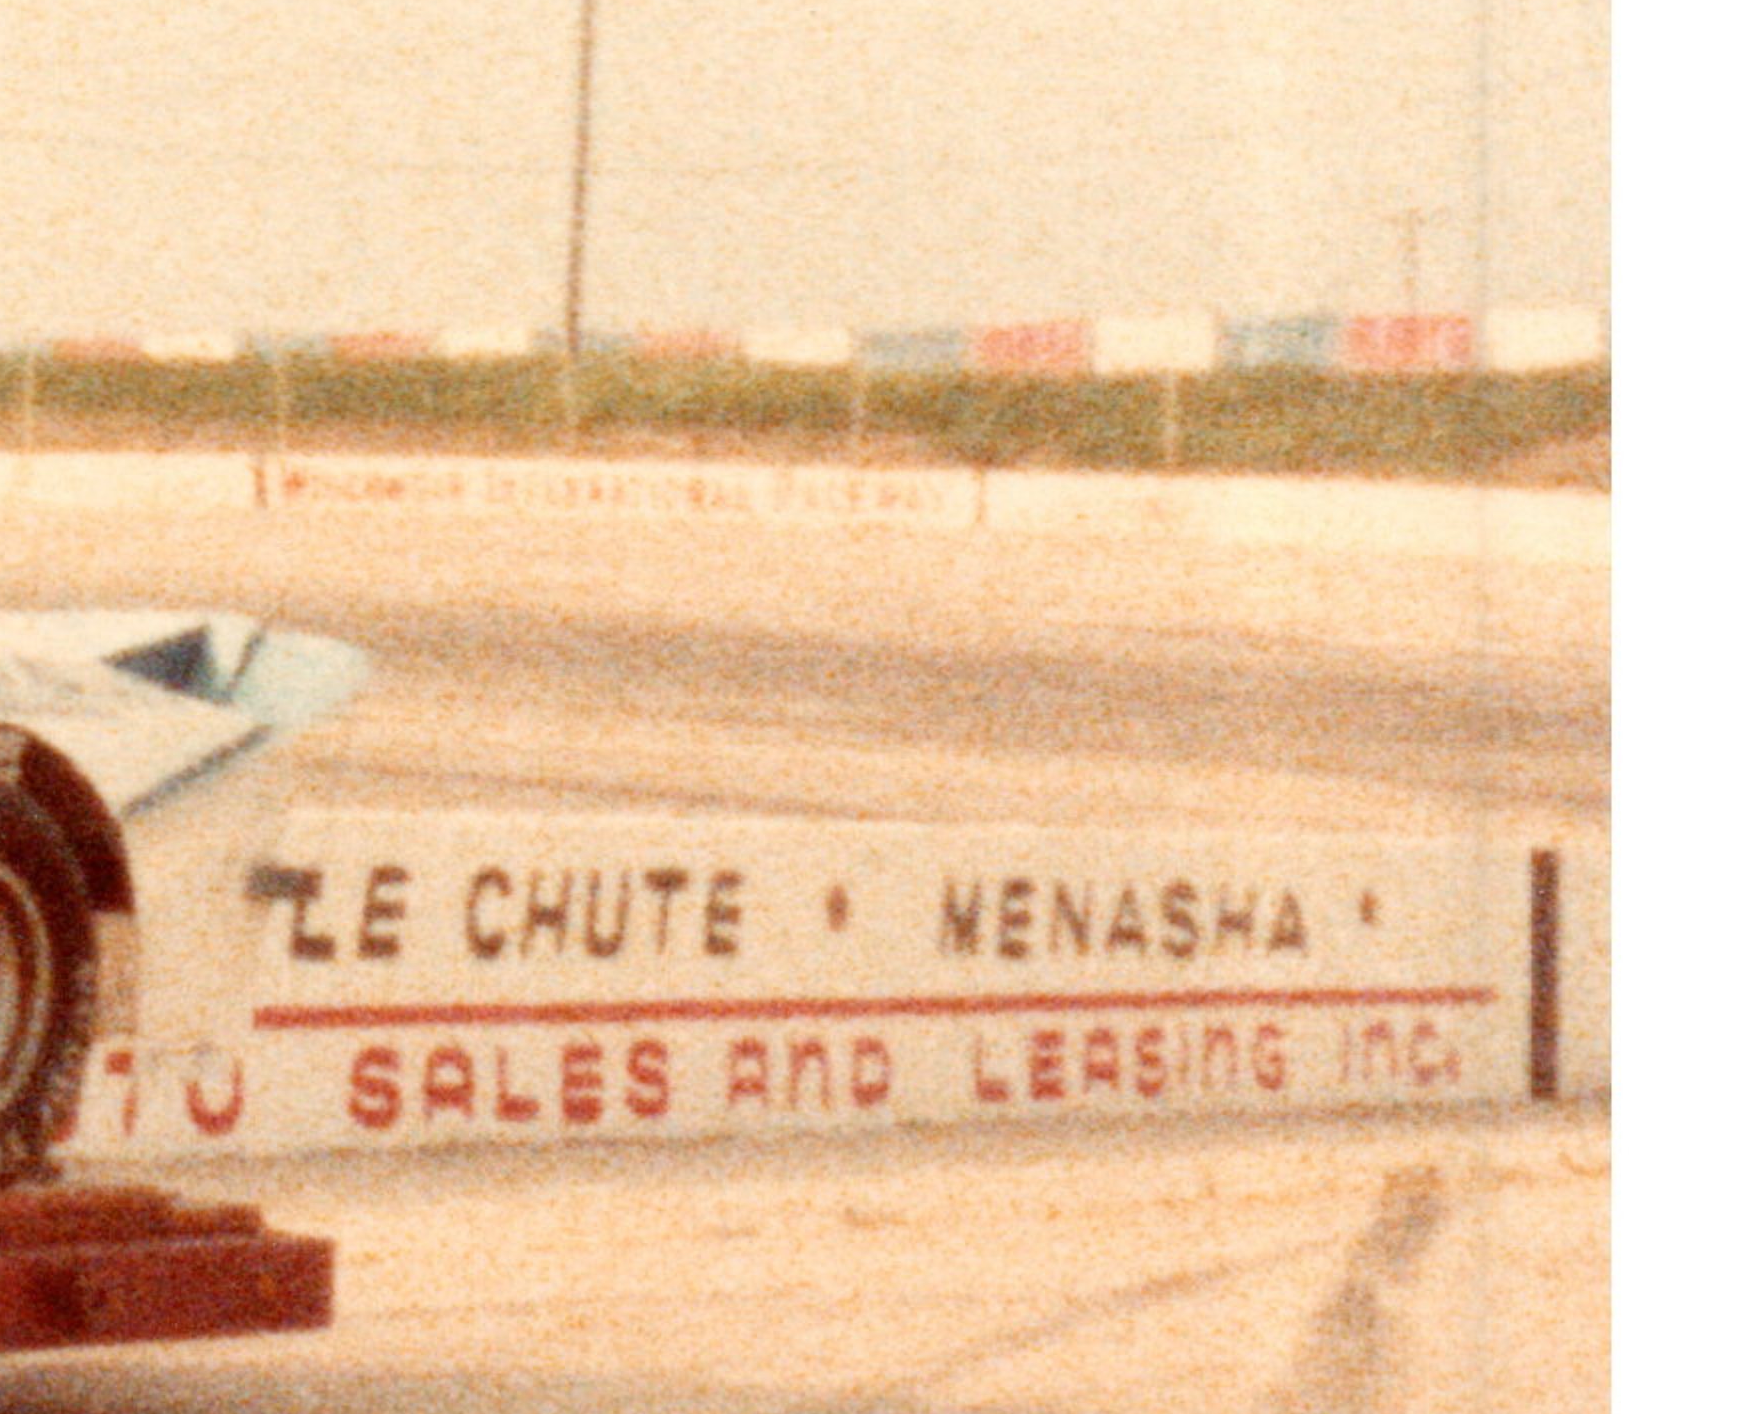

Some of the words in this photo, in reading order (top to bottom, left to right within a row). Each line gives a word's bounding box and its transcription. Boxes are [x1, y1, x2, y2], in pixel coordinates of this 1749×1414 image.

[465, 866, 743, 960] CHUTE
[938, 879, 1309, 958] MENASHA
[346, 1038, 671, 1131] SALES
[725, 1037, 895, 1109] AND
[972, 1023, 1287, 1101] LEASING
